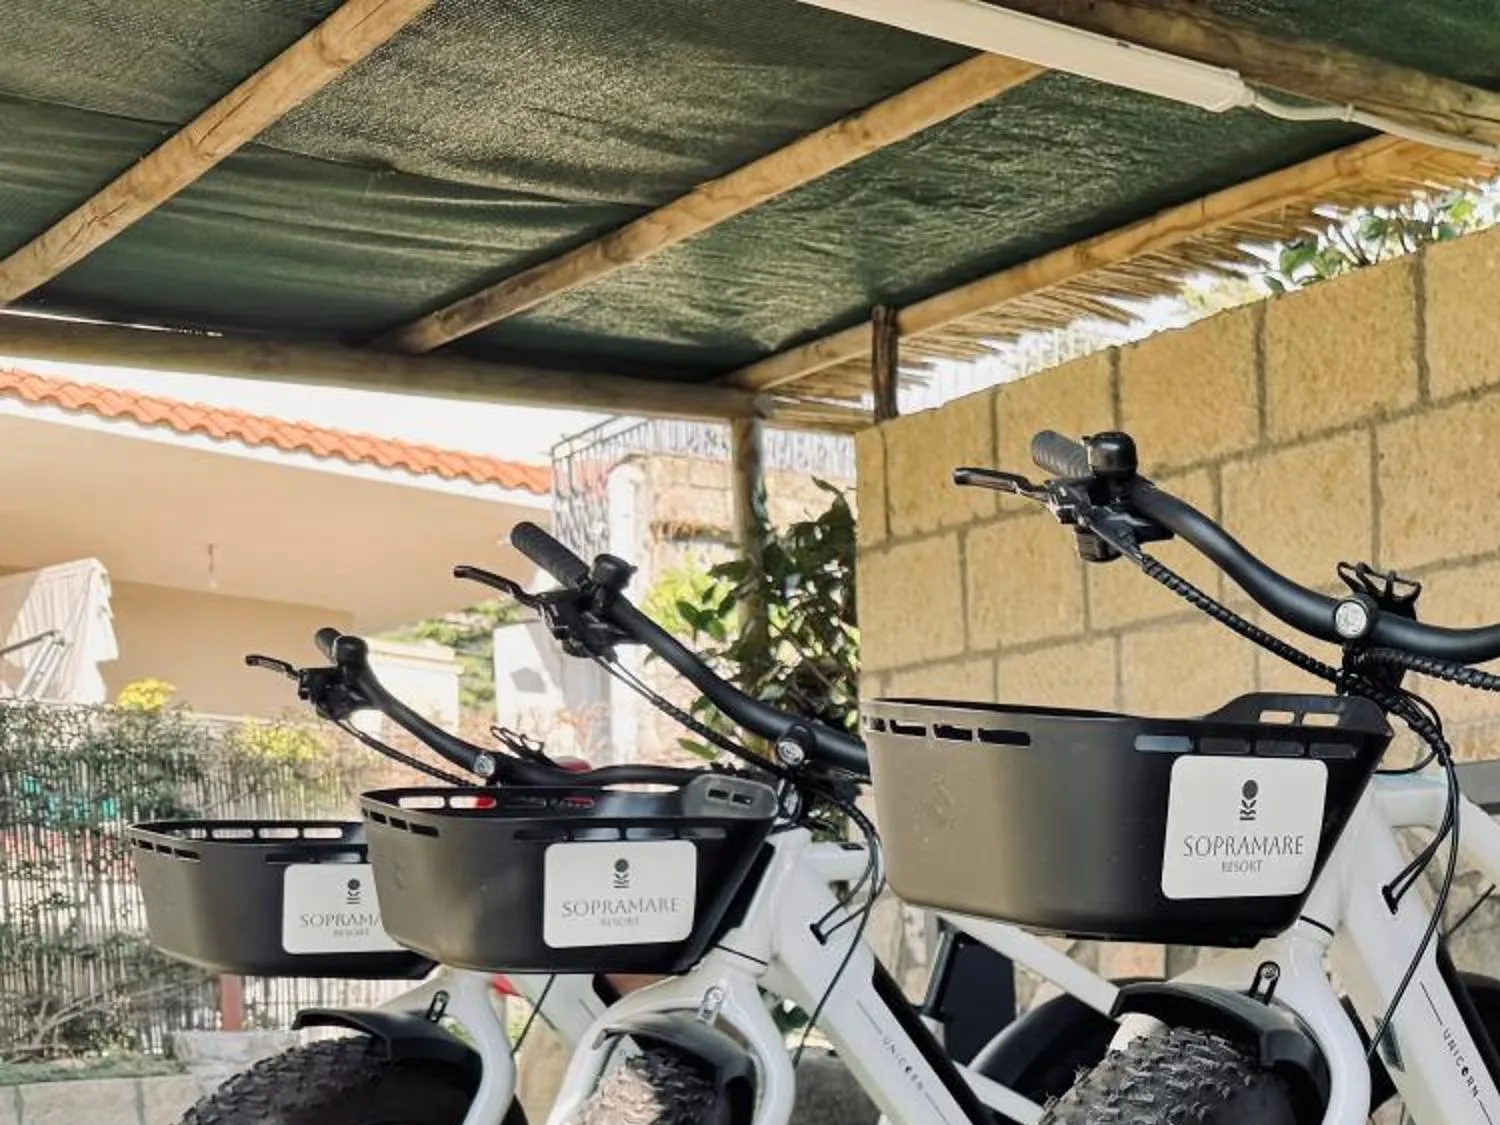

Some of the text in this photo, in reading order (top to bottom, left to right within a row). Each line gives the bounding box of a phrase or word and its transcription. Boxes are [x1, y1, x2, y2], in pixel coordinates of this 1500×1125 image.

[1183, 835, 1303, 857] SOPRAMARE
[1222, 860, 1262, 872] RESORT
[561, 897, 679, 917] SOPRAMARE
[301, 913, 380, 927] SOPRAM
